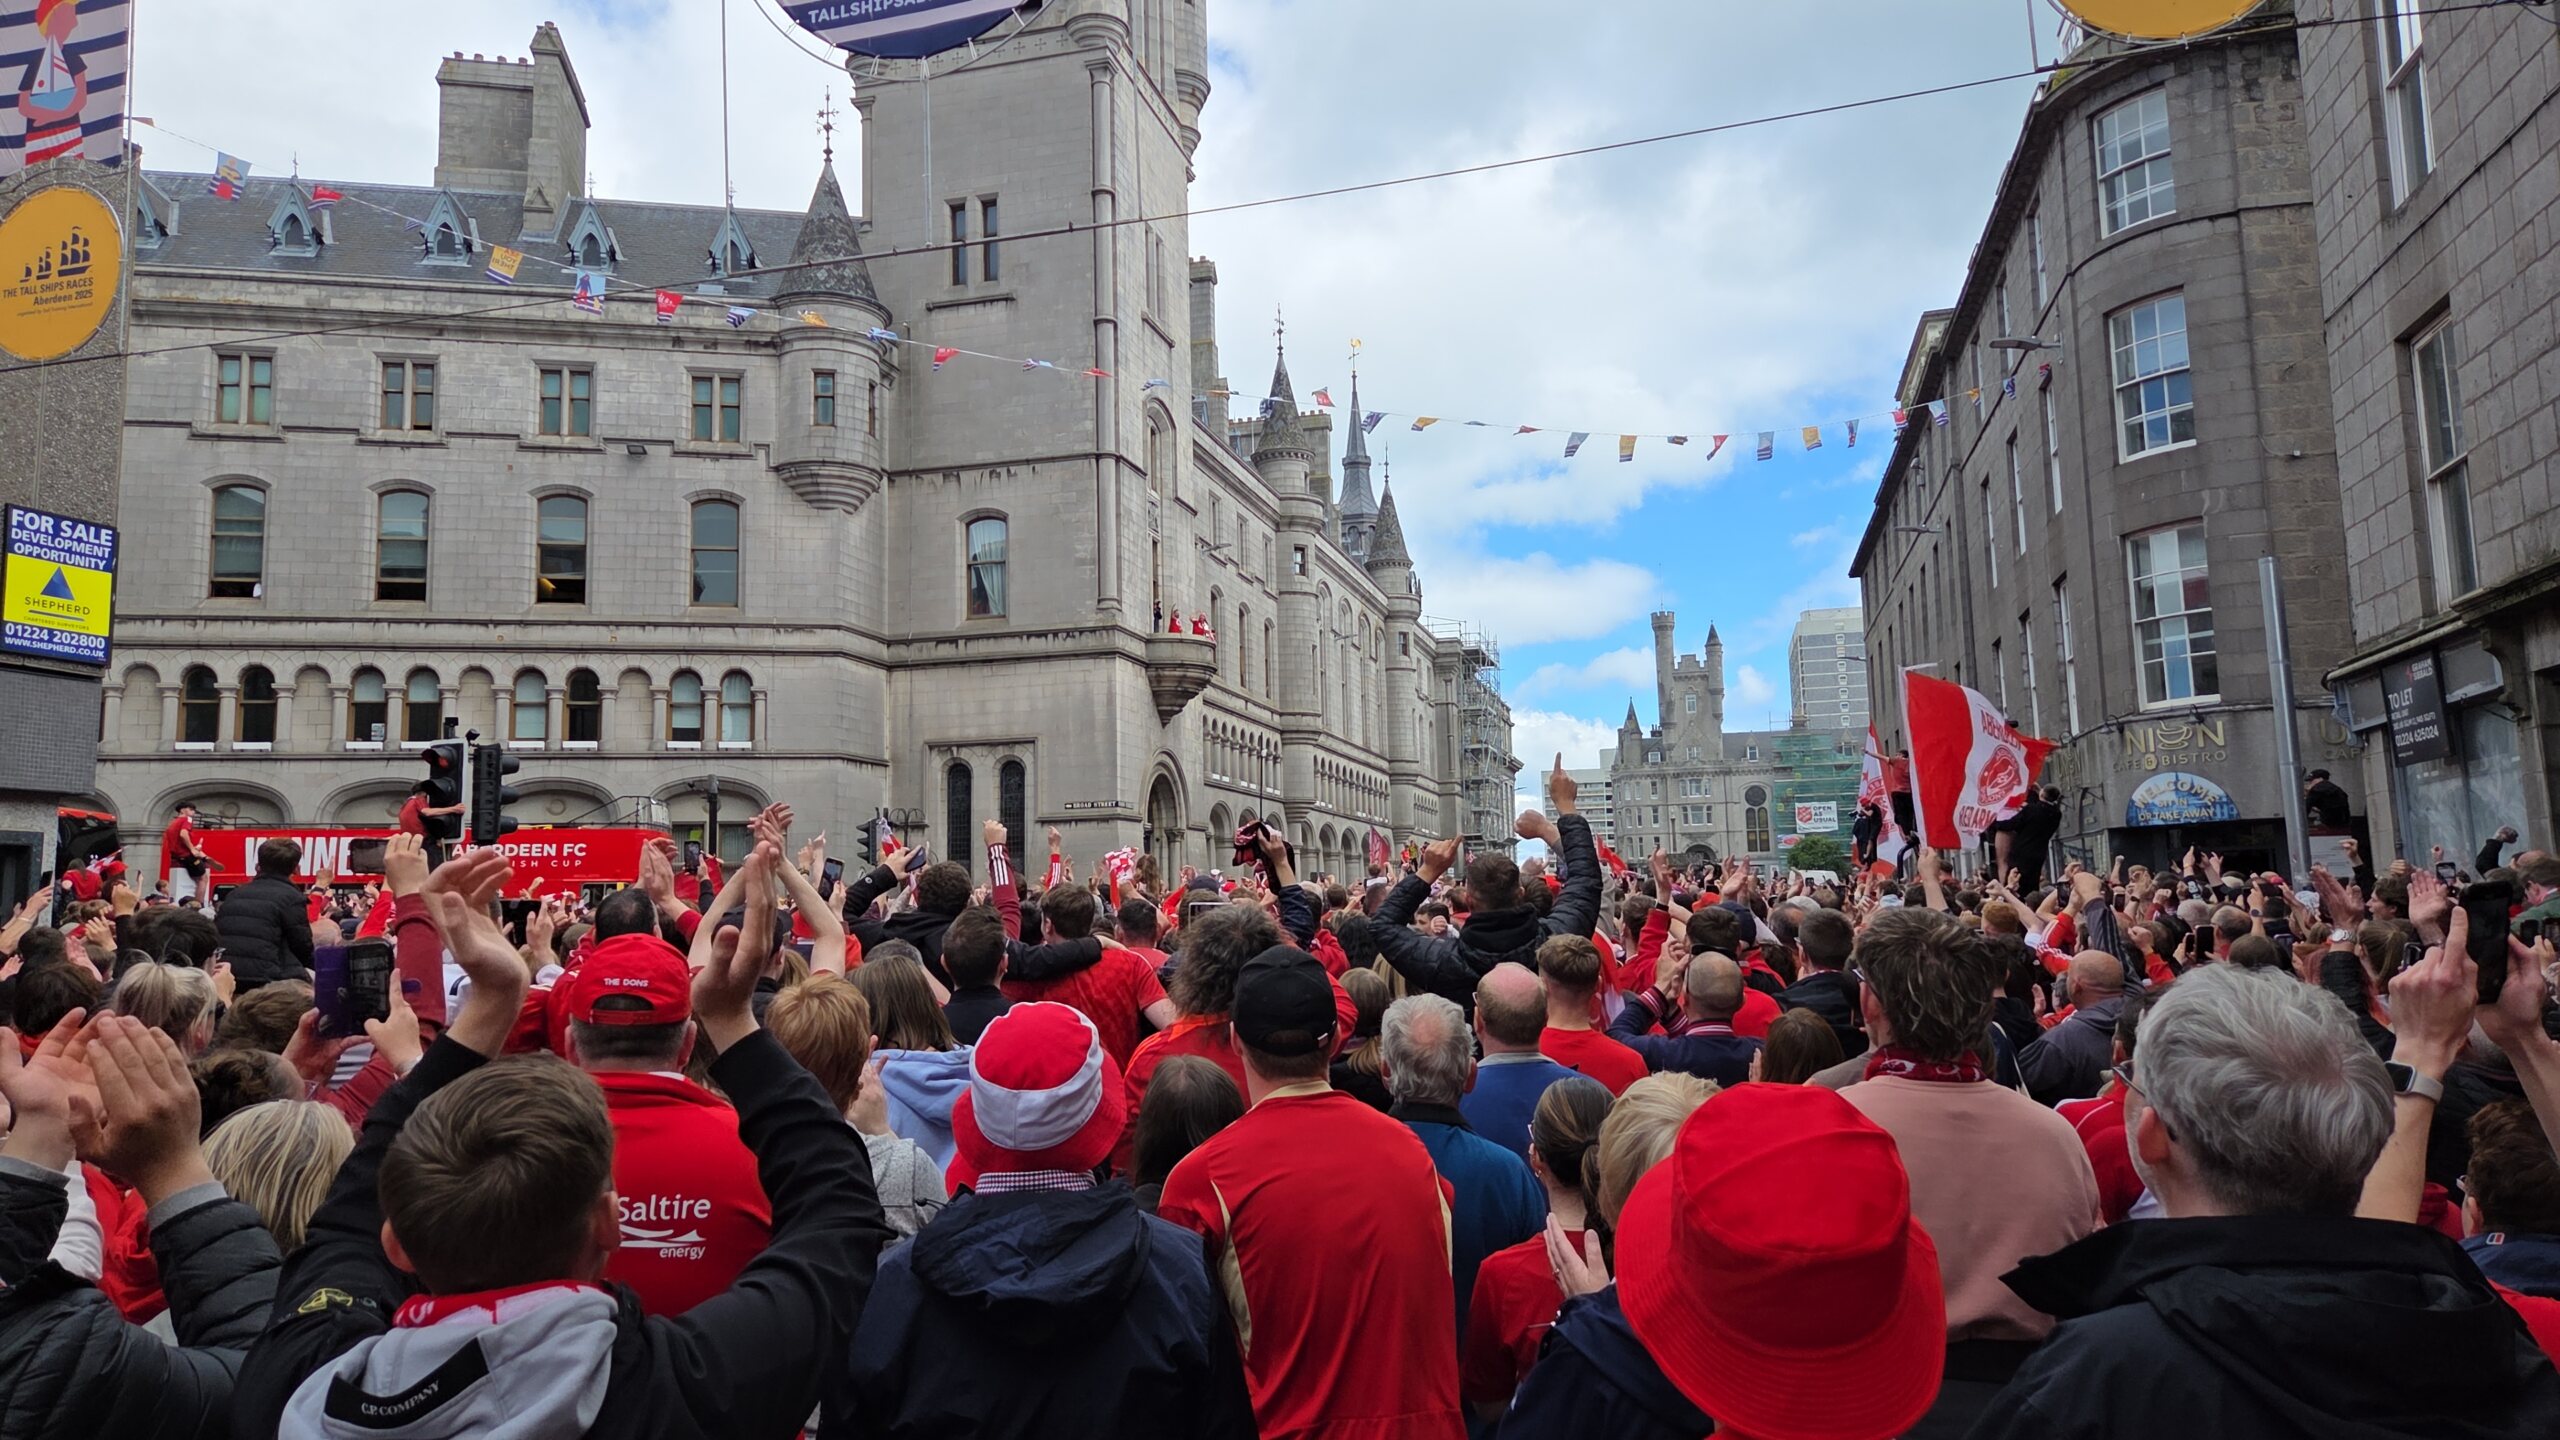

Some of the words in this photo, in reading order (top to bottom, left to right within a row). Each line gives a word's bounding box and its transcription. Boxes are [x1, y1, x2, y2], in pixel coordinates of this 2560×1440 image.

[3, 288, 17, 299] THE
[20, 285, 38, 296] TALL
[40, 281, 65, 293] SHIPS
[66, 277, 94, 290] RACES
[33, 294, 73, 306] Aberdeen
[75, 289, 94, 300] 2025
[11, 508, 54, 535] FOR
[60, 520, 113, 547] SALE
[11, 528, 111, 559] DEVELOPMENT
[14, 542, 107, 571] OPPORTUNITY
[24, 596, 91, 615] SHEPHERD
[5, 622, 49, 641] 01224
[52, 630, 105, 649] 202800
[2388, 692, 2400, 710] TO
[2400, 687, 2413, 707] LET
[2395, 732, 2414, 747] 01224
[2161, 750, 2226, 767] BISTRO
[2134, 779, 2219, 808] WELCOME
[2138, 811, 2152, 820] OR
[2154, 810, 2180, 820] TAKE
[2182, 807, 2214, 819] AWAY
[452, 844, 556, 857] ABRDEEN
[563, 844, 587, 857] FC
[551, 860, 582, 868] CUP
[603, 978, 620, 986] THE
[623, 978, 649, 987] DONS
[618, 1194, 712, 1222] Saltire
[660, 1246, 706, 1260] energy
[379, 1380, 440, 1416] COMPANY
